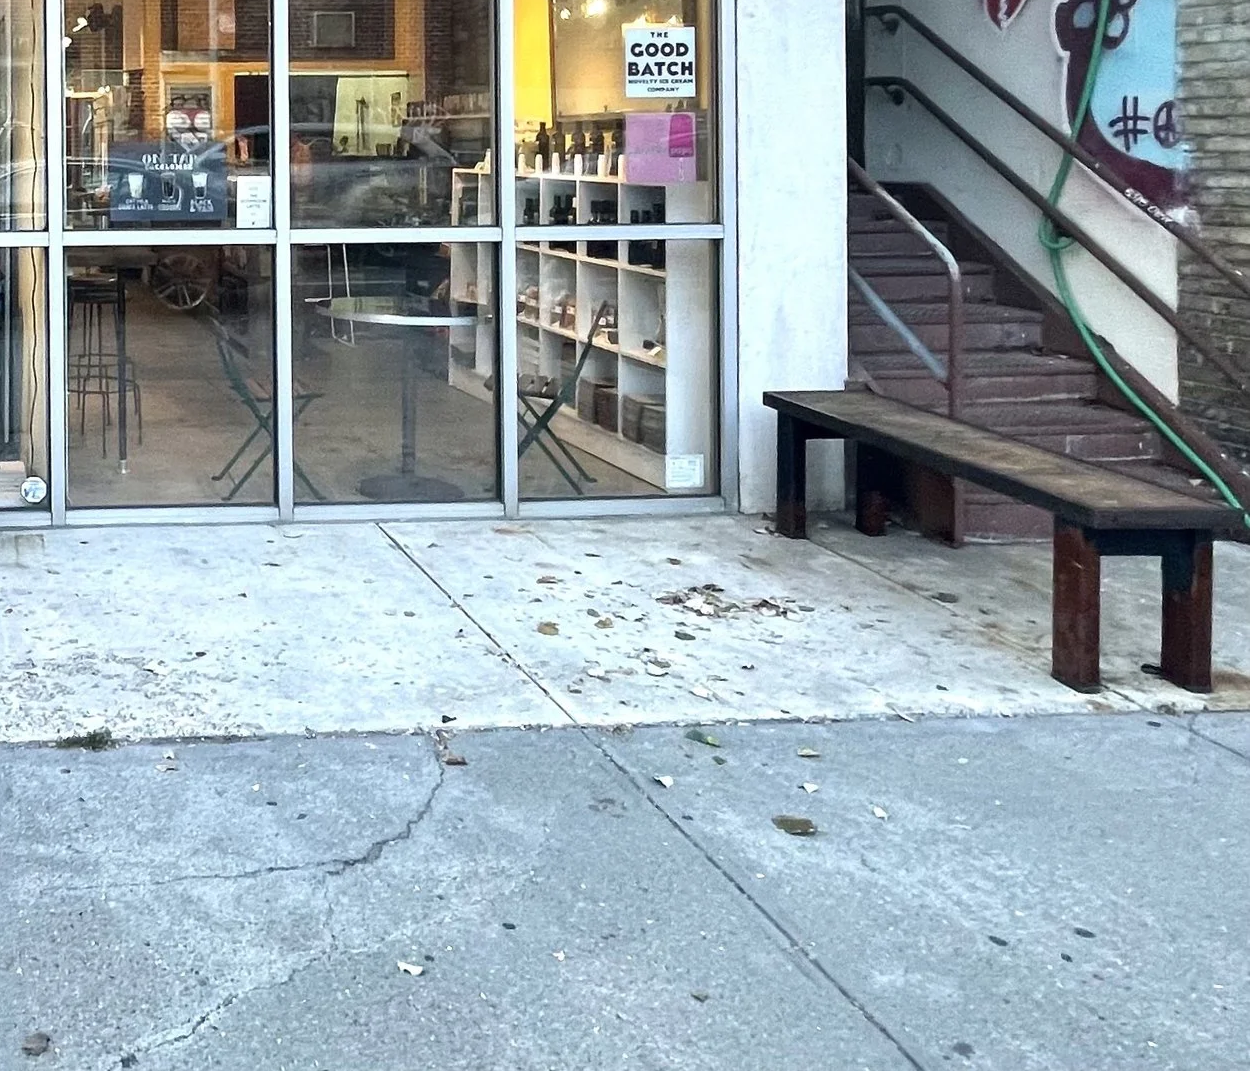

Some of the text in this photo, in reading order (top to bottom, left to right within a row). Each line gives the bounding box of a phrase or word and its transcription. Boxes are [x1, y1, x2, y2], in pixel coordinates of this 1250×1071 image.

[650, 31, 669, 39] THE
[630, 42, 690, 58] GOOD
[627, 61, 694, 77] BATCH
